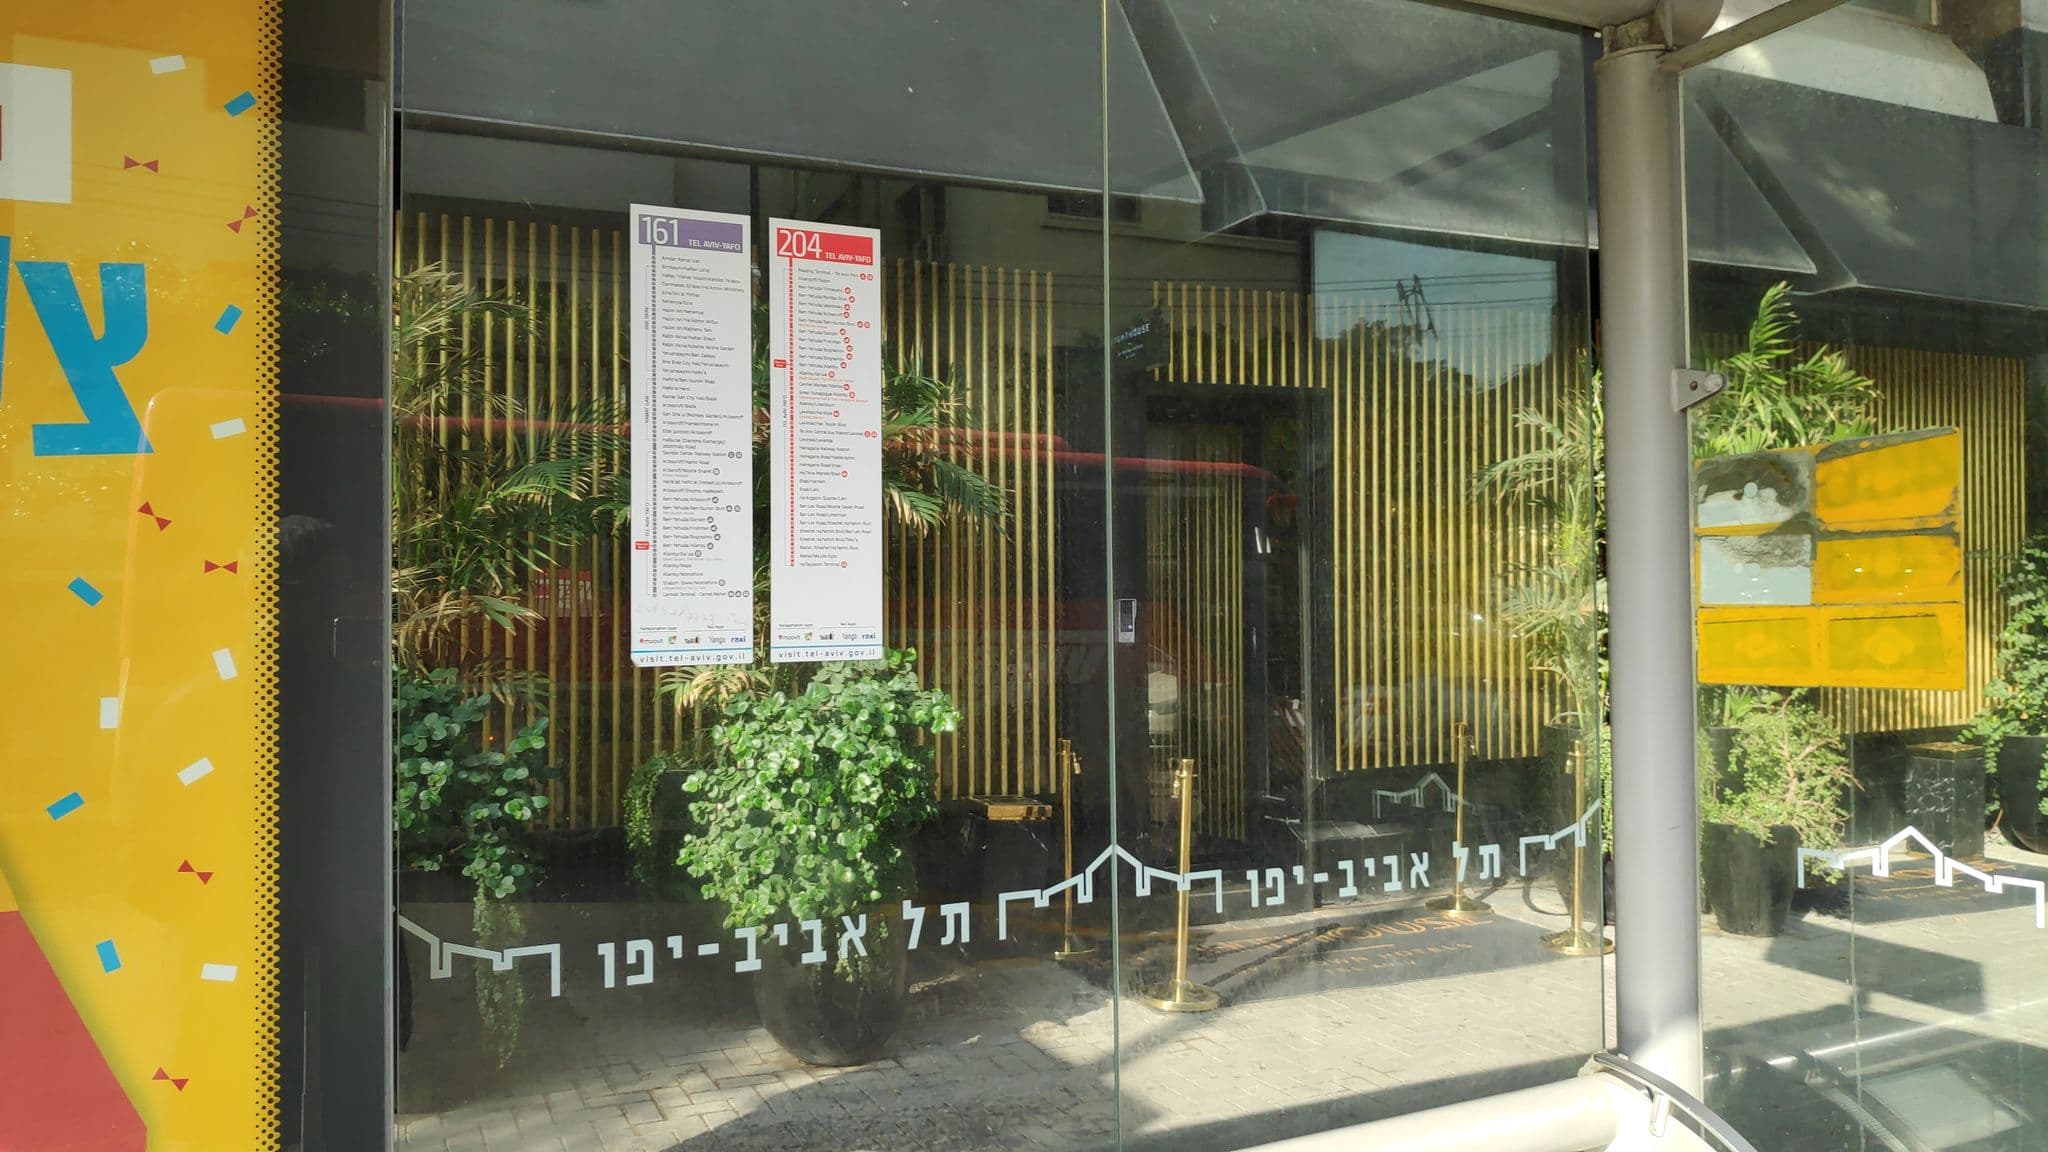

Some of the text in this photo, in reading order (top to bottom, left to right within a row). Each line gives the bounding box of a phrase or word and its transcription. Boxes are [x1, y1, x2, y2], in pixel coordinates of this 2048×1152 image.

[642, 216, 740, 250] 161 TEL AVIV-YAFO
[779, 230, 871, 263] 204 TEL AVIV-YAFO
[640, 653, 745, 663] visit.tel-aviv.gov.il
[779, 649, 875, 658] visit.tel-aviv.gov.il
[1246, 840, 1501, 908] תל אביב-יפו
[598, 900, 970, 989] תל אביב-יפו
